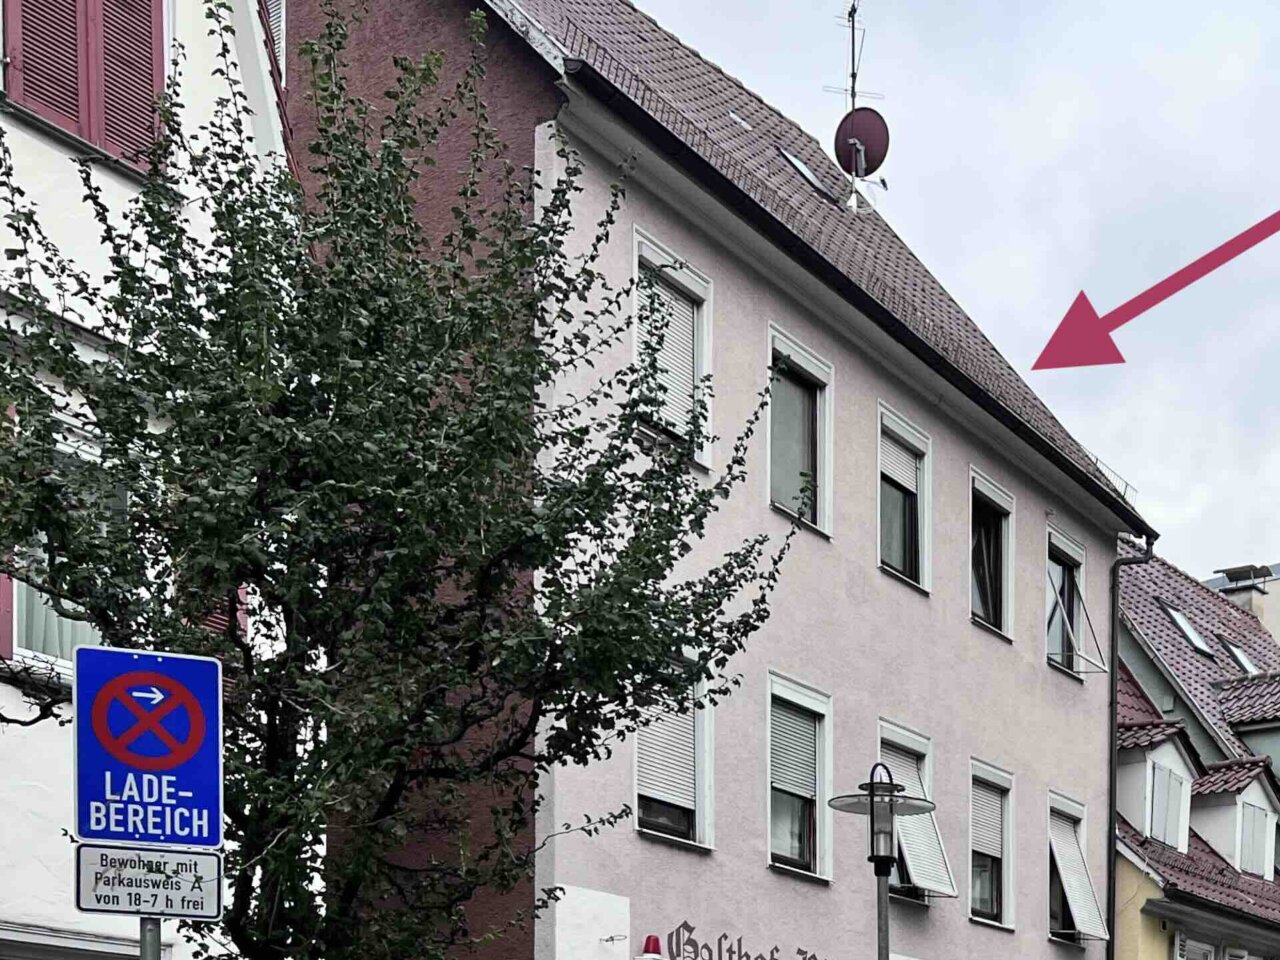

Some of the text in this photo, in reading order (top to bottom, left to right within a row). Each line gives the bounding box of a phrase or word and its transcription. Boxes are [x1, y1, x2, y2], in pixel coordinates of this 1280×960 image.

[104, 770, 194, 805] LADE-
[89, 801, 209, 838] BEREICH
[176, 858, 199, 874] mit
[94, 871, 182, 892] Parkausweis
[94, 892, 205, 911] von 18-7 h frei
